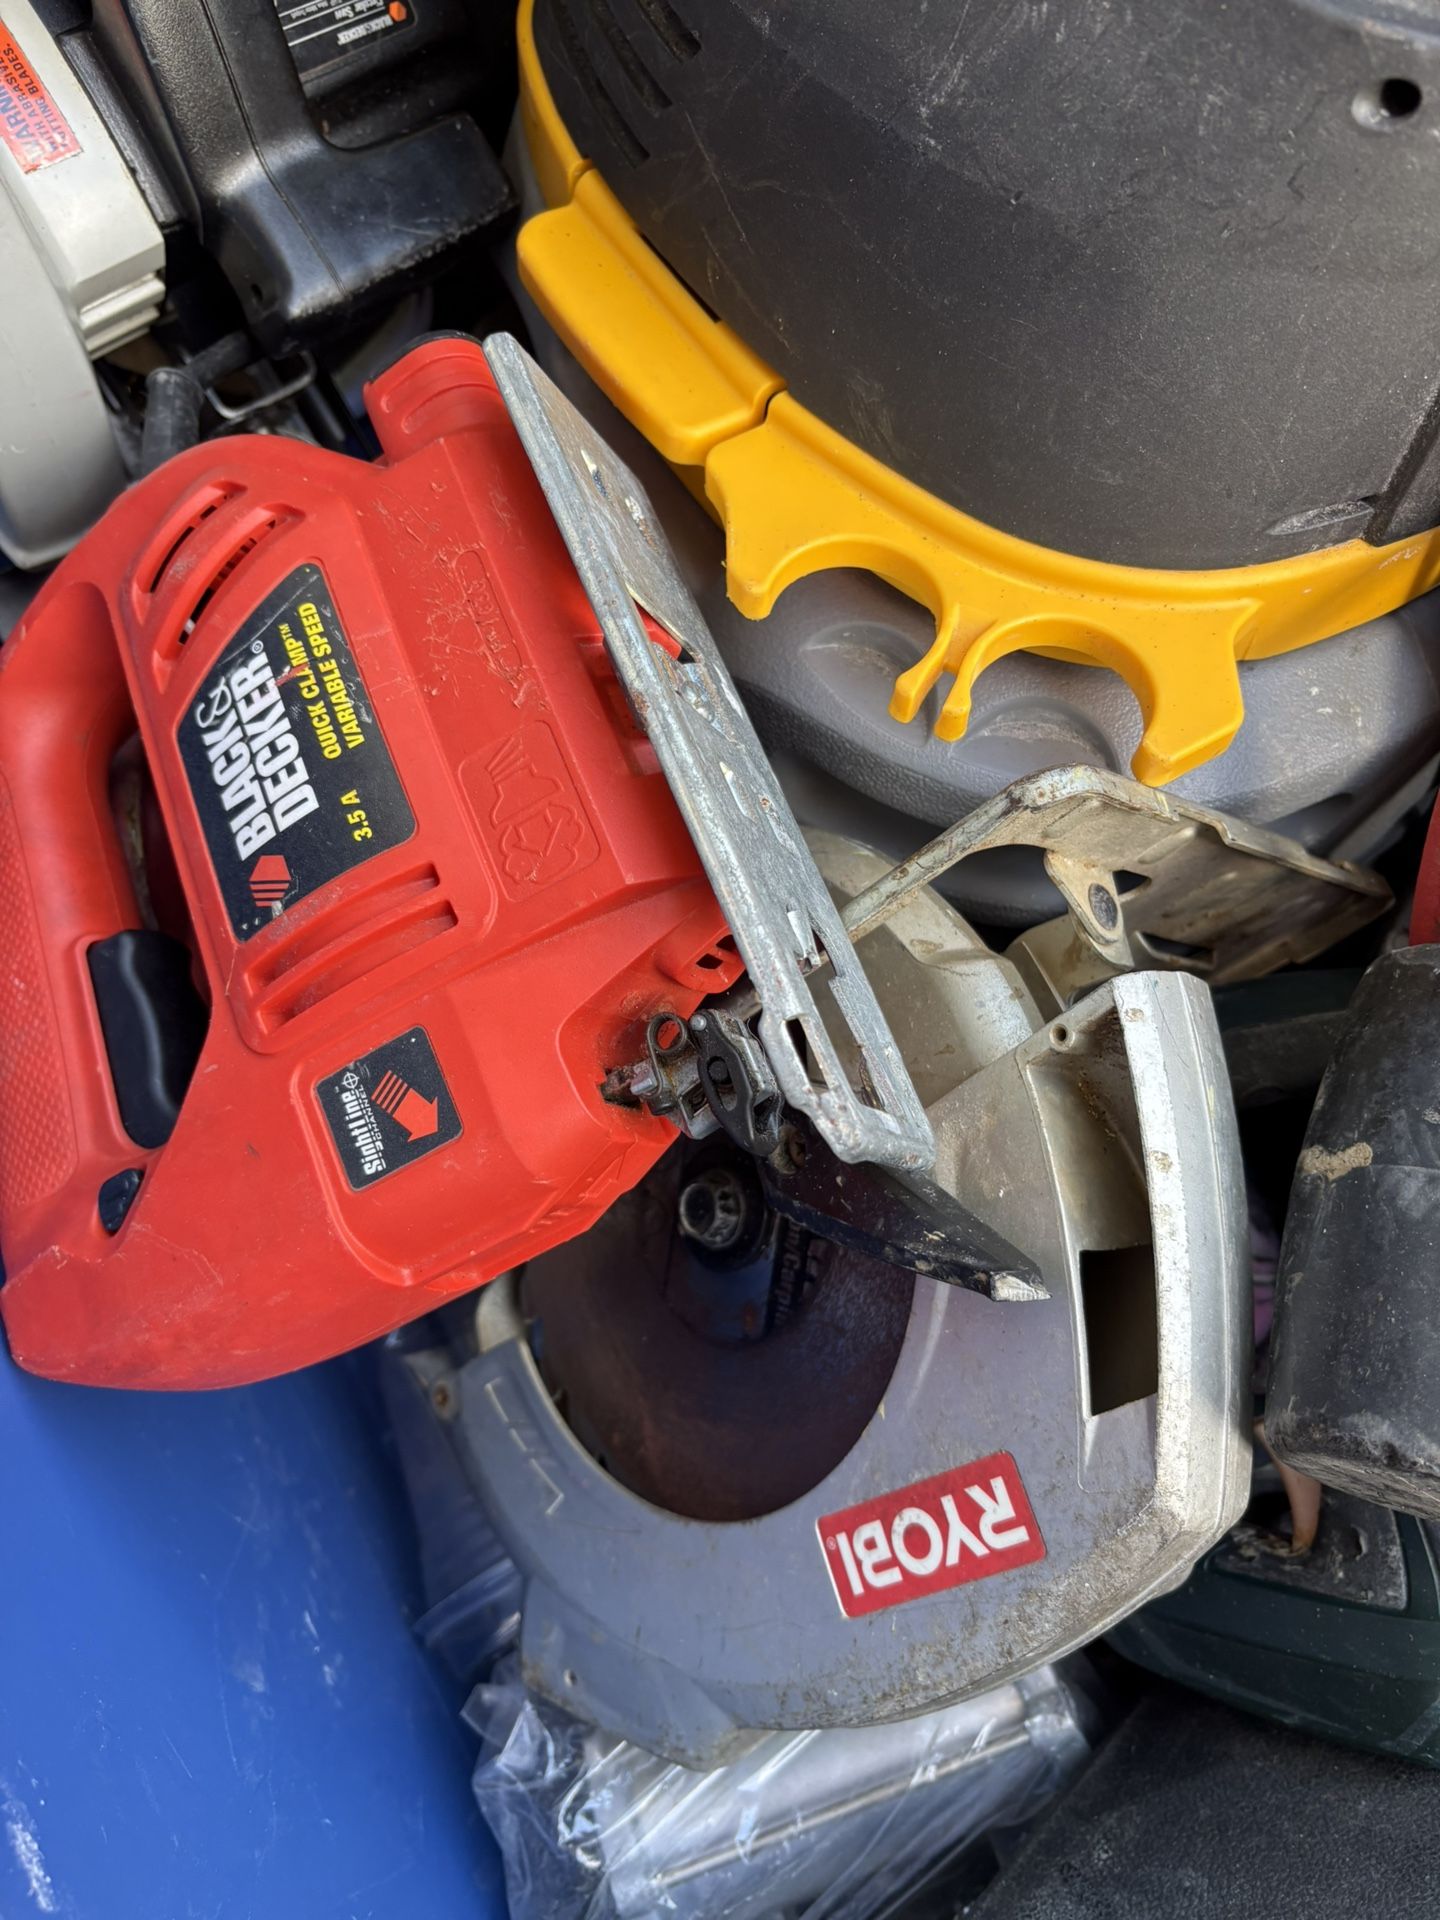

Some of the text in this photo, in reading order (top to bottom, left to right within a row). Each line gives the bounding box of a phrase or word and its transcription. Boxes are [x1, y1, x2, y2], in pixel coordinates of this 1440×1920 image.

[3, 43, 39, 95] BLADES.
[297, 602, 366, 749] VARIABLE SPEED
[307, 700, 342, 761] QUICK
[339, 789, 373, 842] 3.5 A
[359, 1084, 383, 1140] CHANNEL
